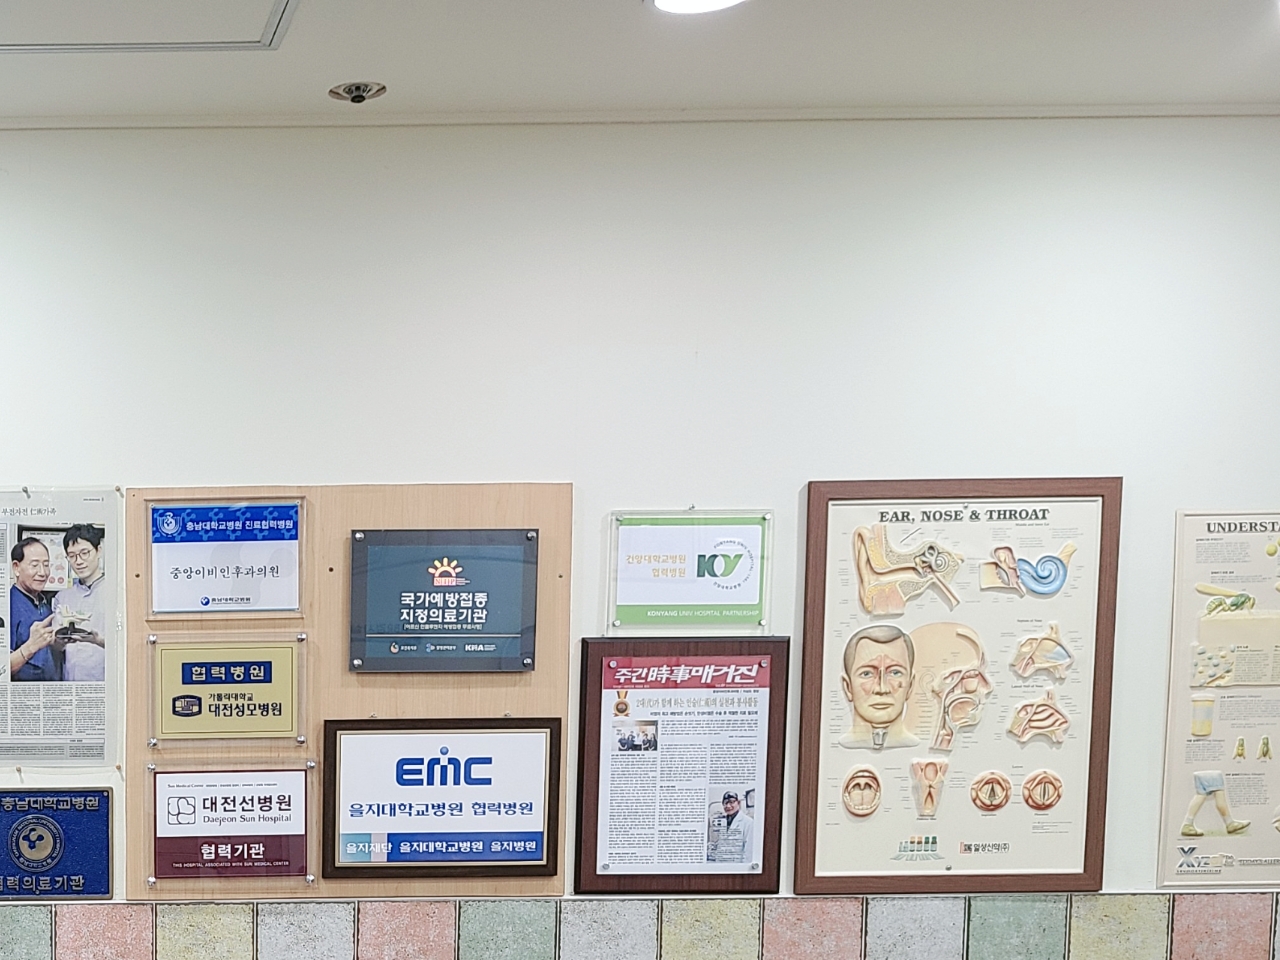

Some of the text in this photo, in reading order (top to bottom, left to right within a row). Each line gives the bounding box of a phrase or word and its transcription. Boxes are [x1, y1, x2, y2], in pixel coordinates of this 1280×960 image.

[879, 508, 1051, 524] EAR, NOSE & THROAT
[170, 565, 280, 580] 중앙이비인후과의원
[400, 592, 488, 608] 국가예방접종
[400, 608, 488, 624] 지정의료기관
[192, 666, 264, 680] 협력병원
[614, 664, 759, 684] 주간時事매거진
[208, 692, 254, 702] 가톨릭대학교
[208, 702, 282, 718] 대전성모병원
[395, 746, 493, 787] EMC
[1, 796, 100, 810] 충남대학교병원
[202, 794, 292, 813] 대전선병원
[348, 801, 534, 818] 을지대학교병원 협력병원
[203, 814, 292, 826] Daejeon Sun Hospital
[200, 843, 265, 860] 협력기관
[345, 840, 536, 854] 을지재단 을지대학교병원 을지병원
